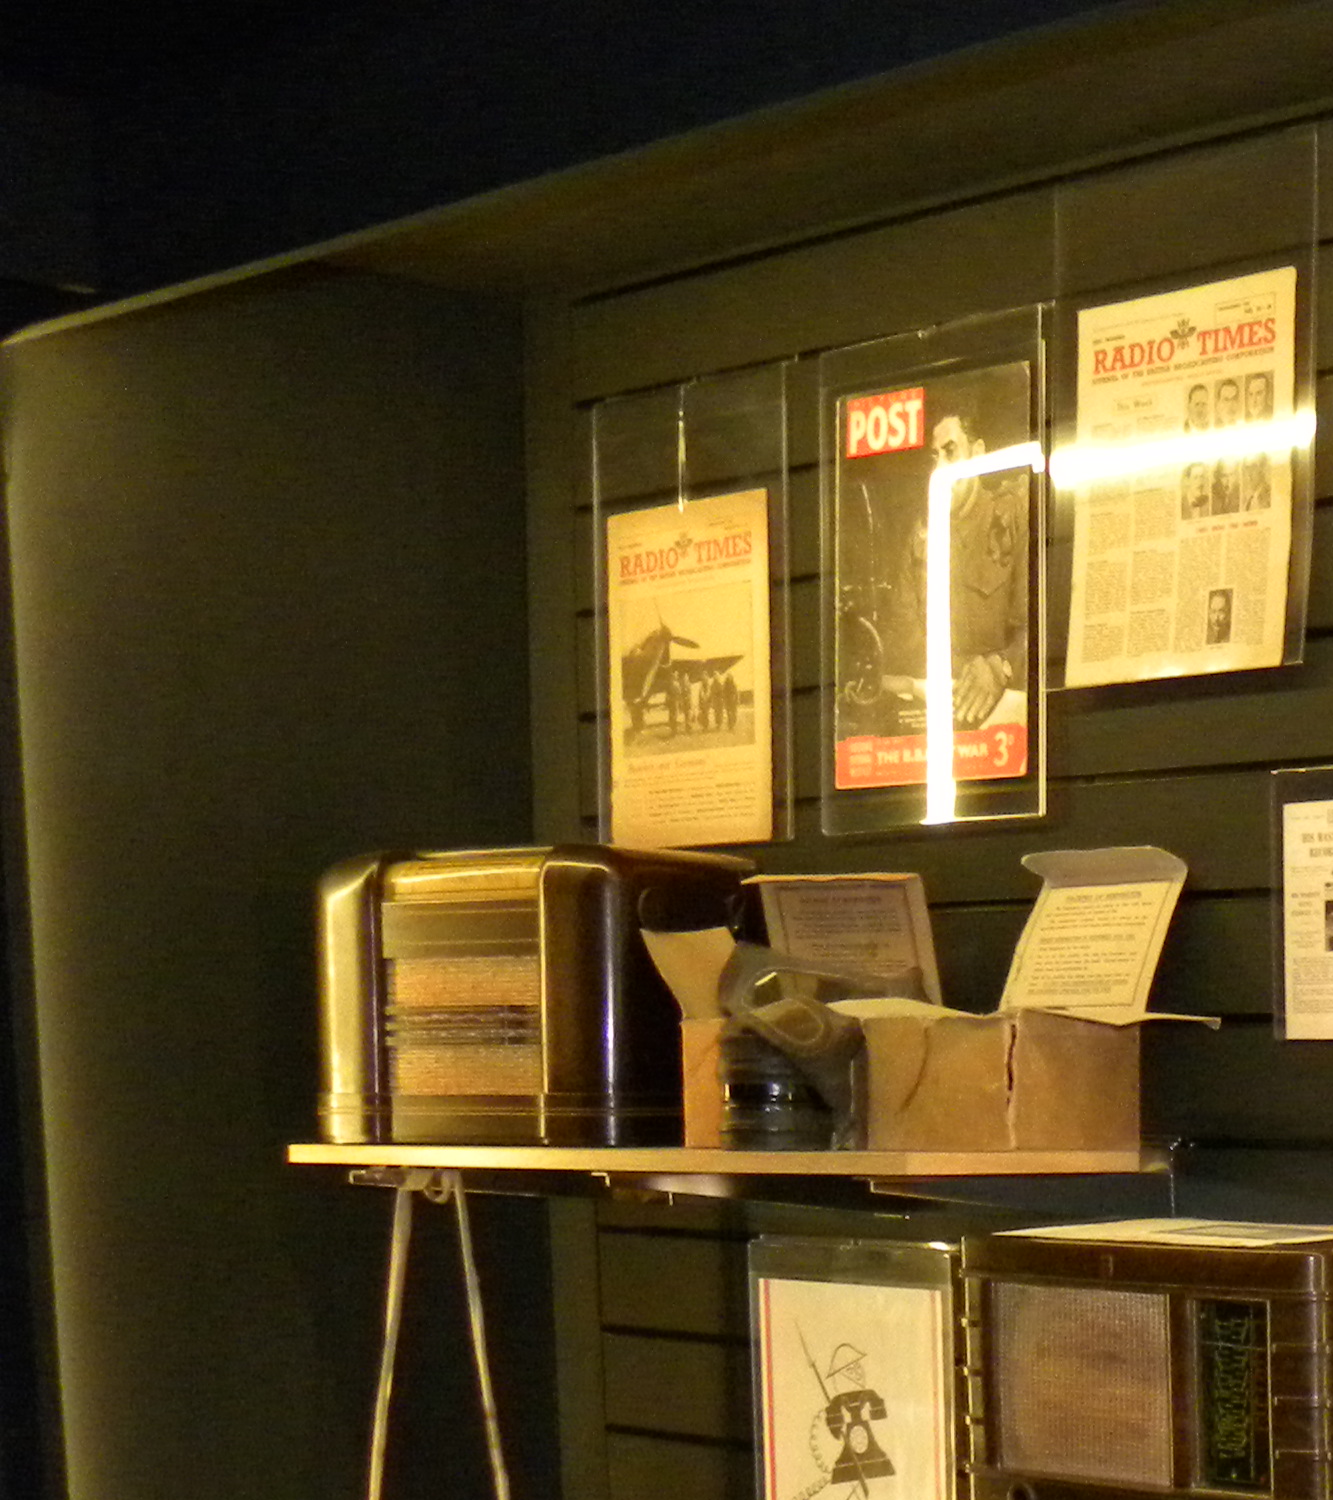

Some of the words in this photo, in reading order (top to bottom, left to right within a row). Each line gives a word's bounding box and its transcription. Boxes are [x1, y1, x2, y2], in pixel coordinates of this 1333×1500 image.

[1092, 338, 1175, 375] RADIO
[1197, 318, 1276, 356] TIMES
[849, 400, 922, 455] POST
[619, 548, 678, 578] RADIO
[695, 531, 752, 564] TIMES
